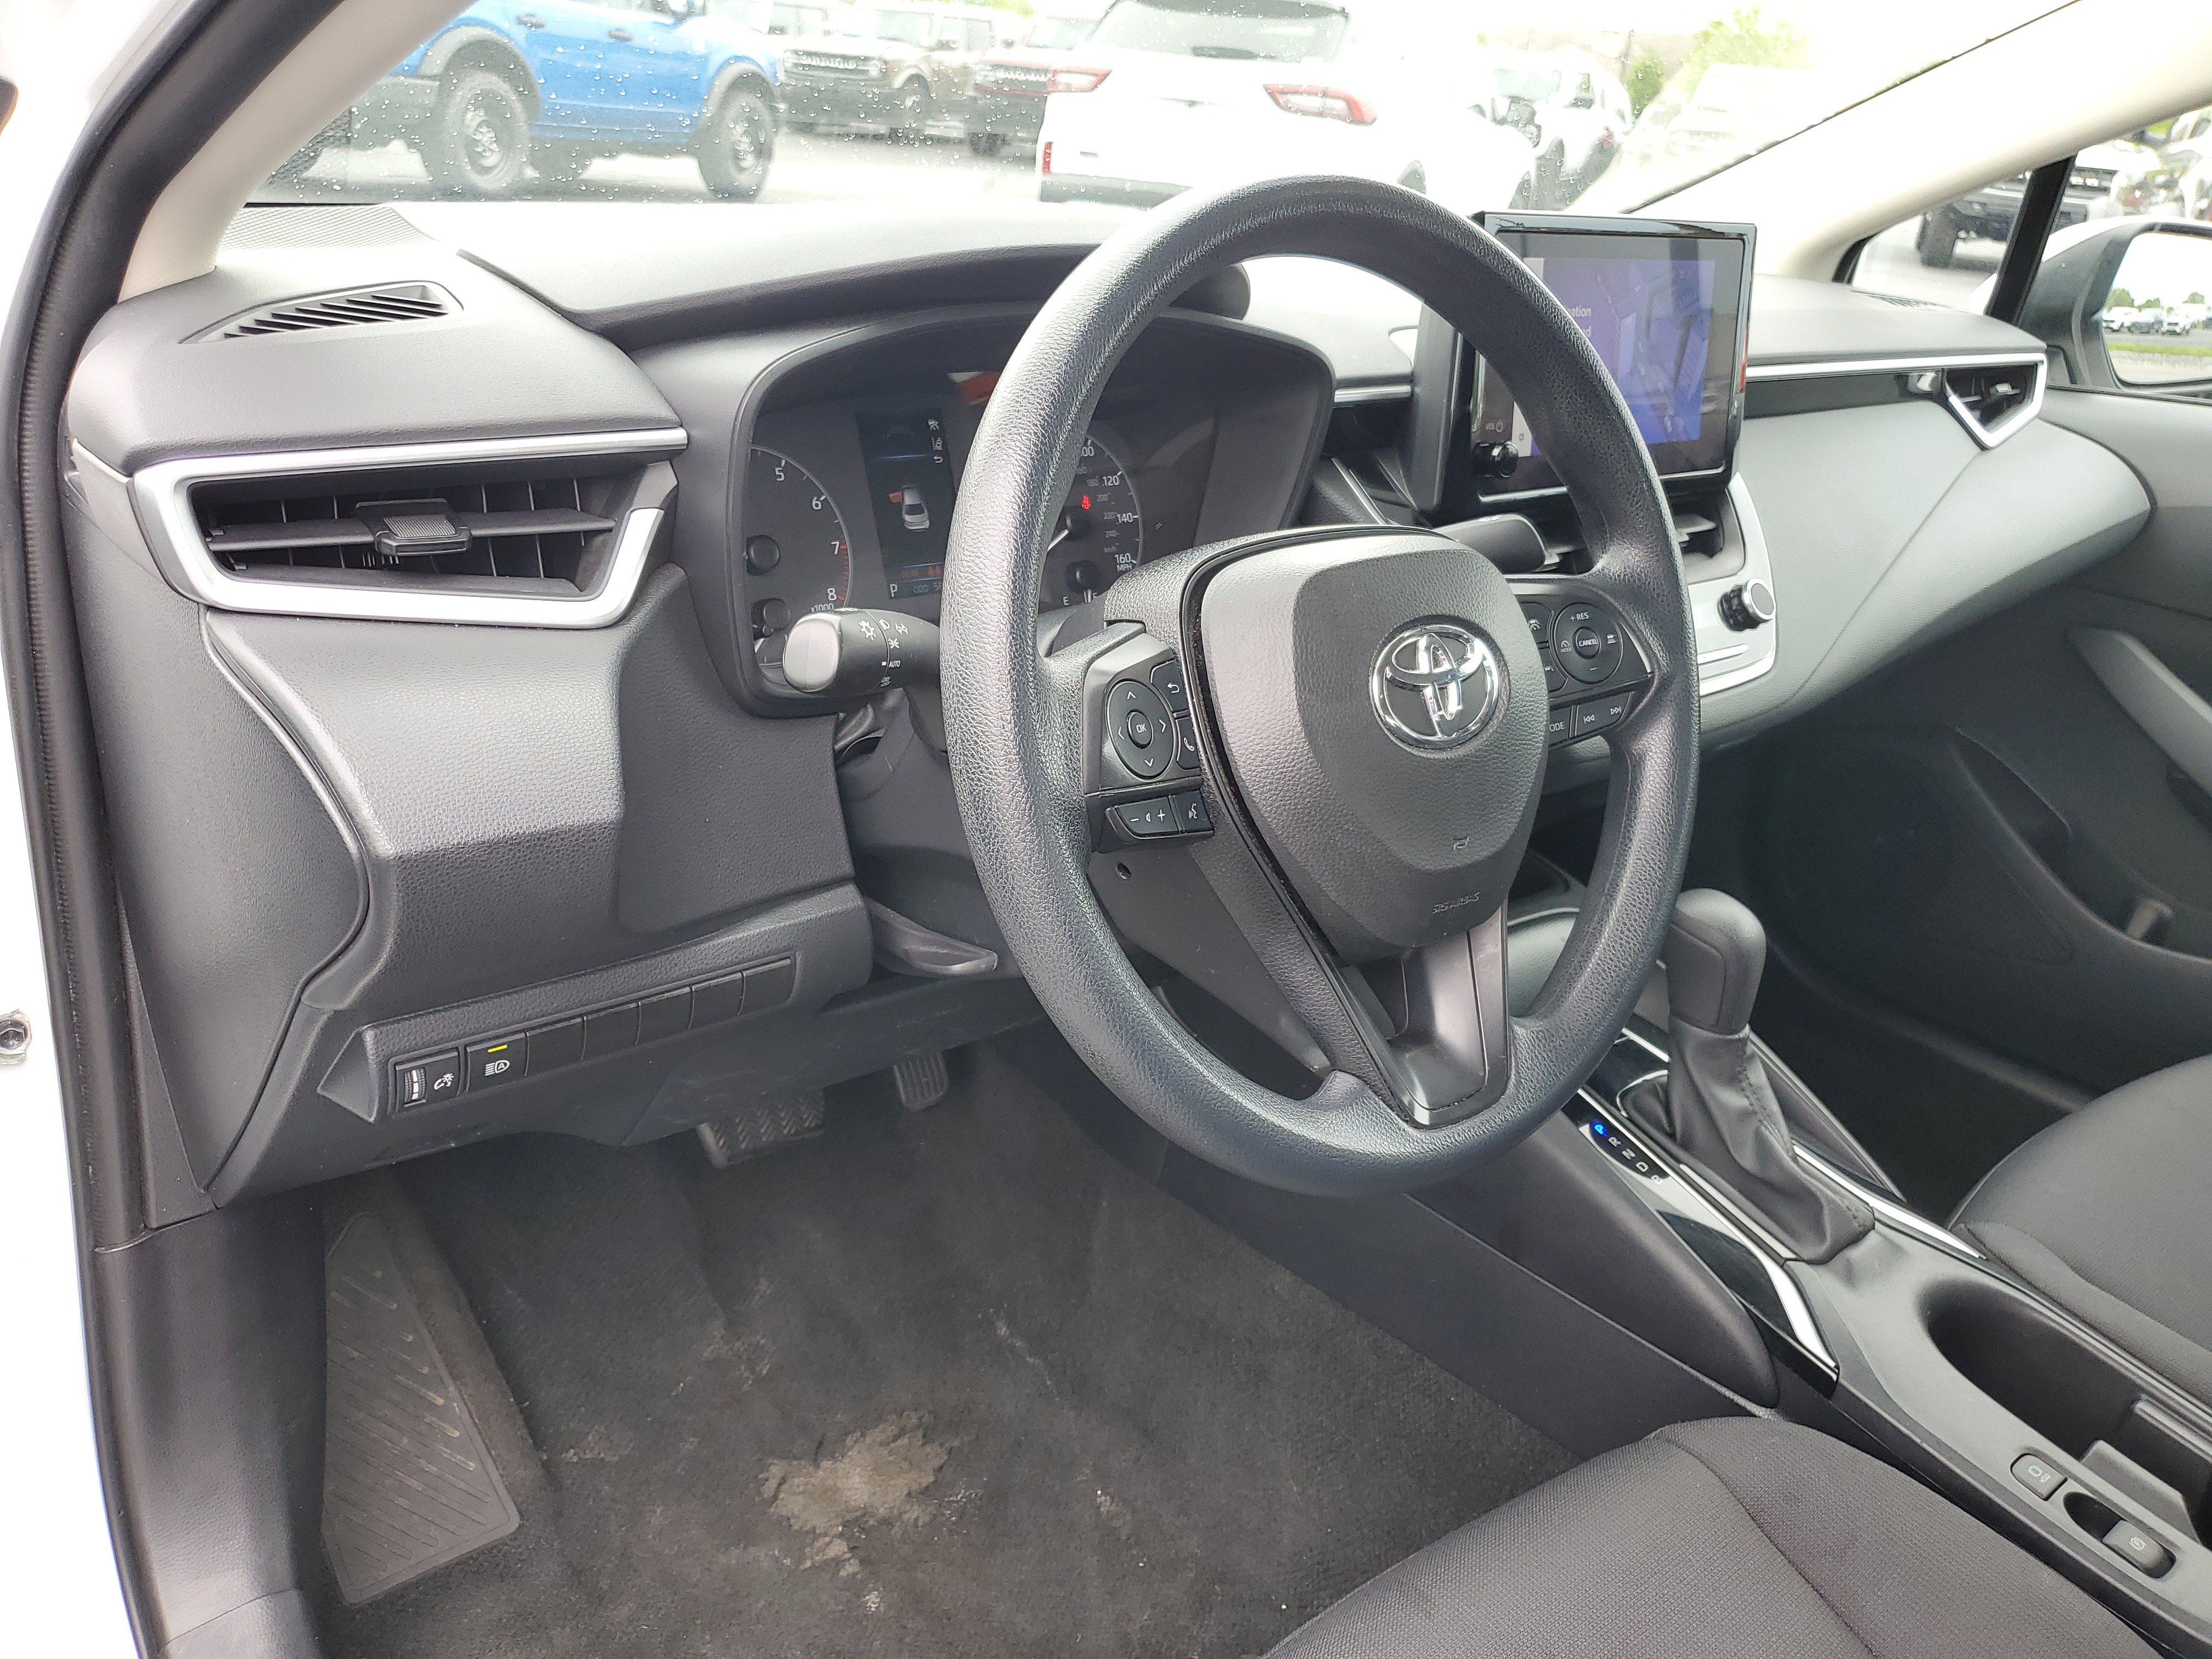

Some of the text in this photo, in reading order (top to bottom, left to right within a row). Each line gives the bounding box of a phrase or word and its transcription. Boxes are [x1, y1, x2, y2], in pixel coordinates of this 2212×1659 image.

[1080, 446, 1094, 457] 00
[775, 467, 785, 481] 5
[1102, 475, 1119, 486] 120
[812, 496, 822, 510] 6
[1116, 512, 1132, 523] 140
[831, 541, 840, 555] 7
[1114, 553, 1131, 563] 160
[827, 588, 837, 601] 8
[890, 584, 898, 597] P
[1063, 596, 1069, 605] E
[1577, 612, 1589, 620] RES
[1578, 638, 1598, 647] CANCEL
[1136, 725, 1147, 733] OK
[1549, 722, 1565, 732] ODE
[1594, 1124, 1606, 1135] P
[1607, 1136, 1622, 1147] R
[1622, 1148, 1636, 1160] N
[1635, 1161, 1649, 1172] D
